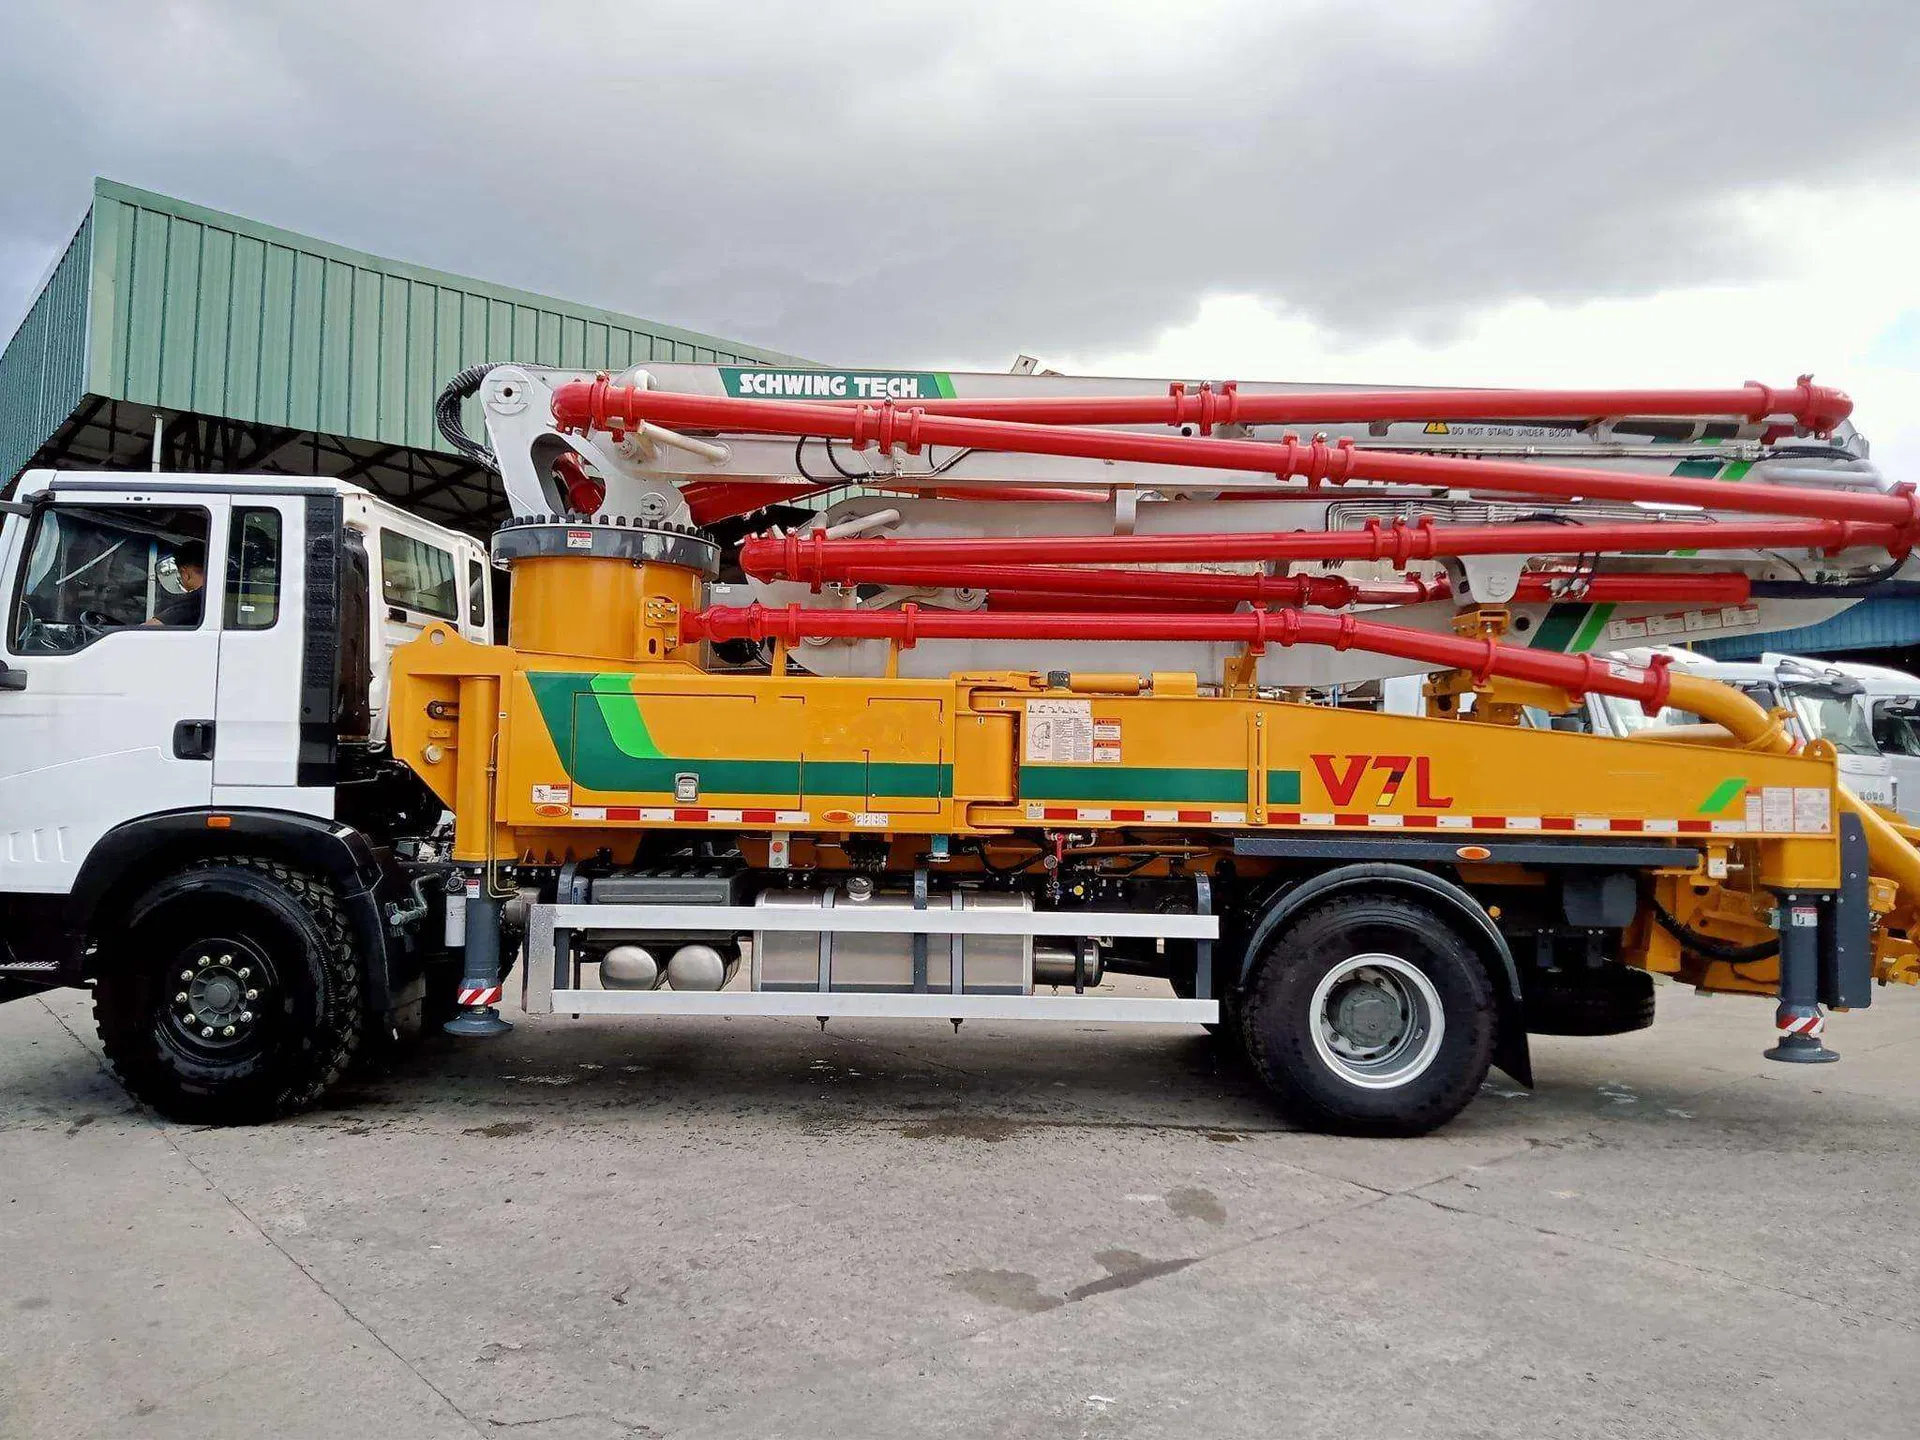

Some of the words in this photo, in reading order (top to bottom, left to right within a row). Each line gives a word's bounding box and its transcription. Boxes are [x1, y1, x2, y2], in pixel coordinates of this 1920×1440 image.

[740, 373, 846, 396] SCHWING
[1451, 426, 1464, 436] DO
[1467, 427, 1484, 436] NOT
[1487, 427, 1514, 437] STAND
[1517, 428, 1545, 437] UNDER
[1548, 428, 1572, 438] BOOM
[1310, 754, 1454, 809] V7L
